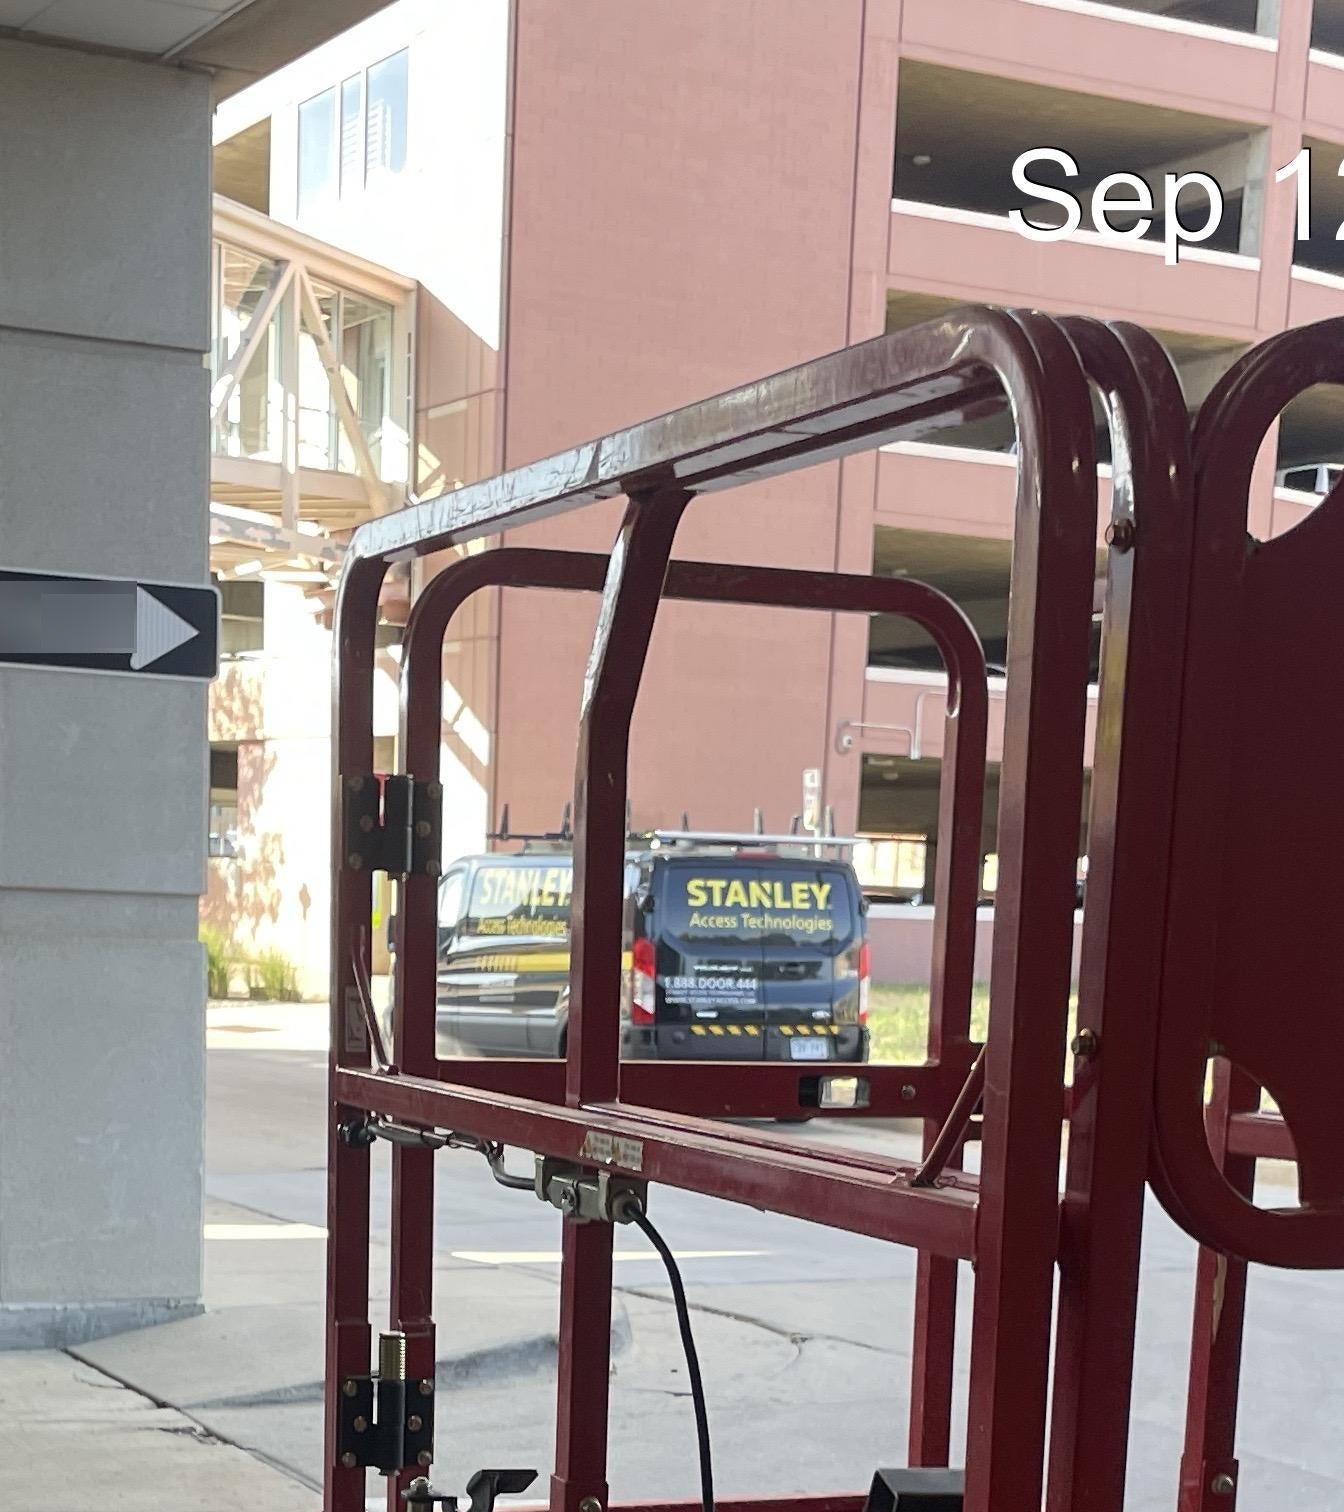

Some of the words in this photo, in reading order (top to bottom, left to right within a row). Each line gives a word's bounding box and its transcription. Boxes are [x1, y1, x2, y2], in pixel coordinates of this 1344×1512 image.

[686, 878, 830, 910] STANLEY
[689, 911, 737, 929] Access
[741, 913, 832, 933] Technologies
